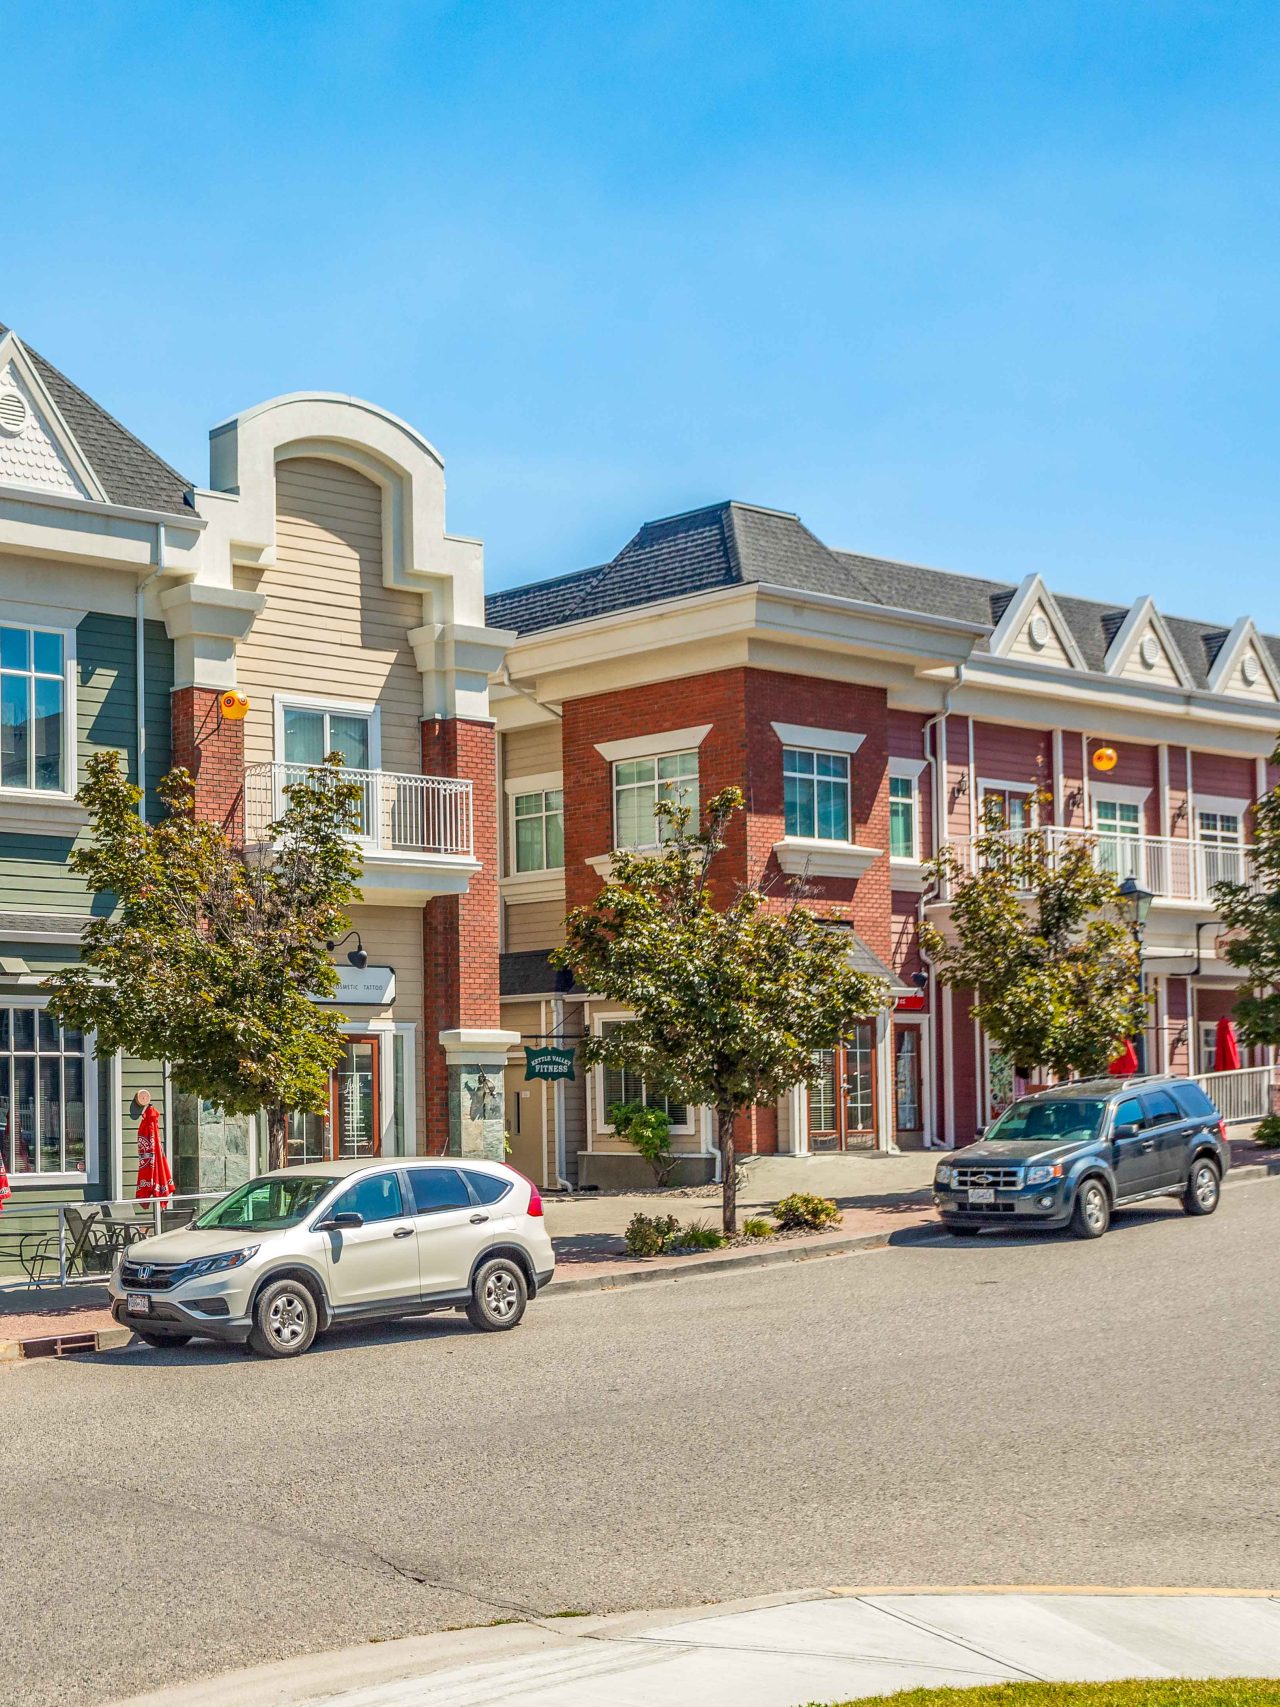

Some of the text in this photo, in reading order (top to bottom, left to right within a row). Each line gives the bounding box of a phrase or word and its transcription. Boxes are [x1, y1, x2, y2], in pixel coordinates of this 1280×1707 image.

[531, 1056, 571, 1066] KETTLE VALLEY
[535, 1064, 568, 1073] FITNESS
